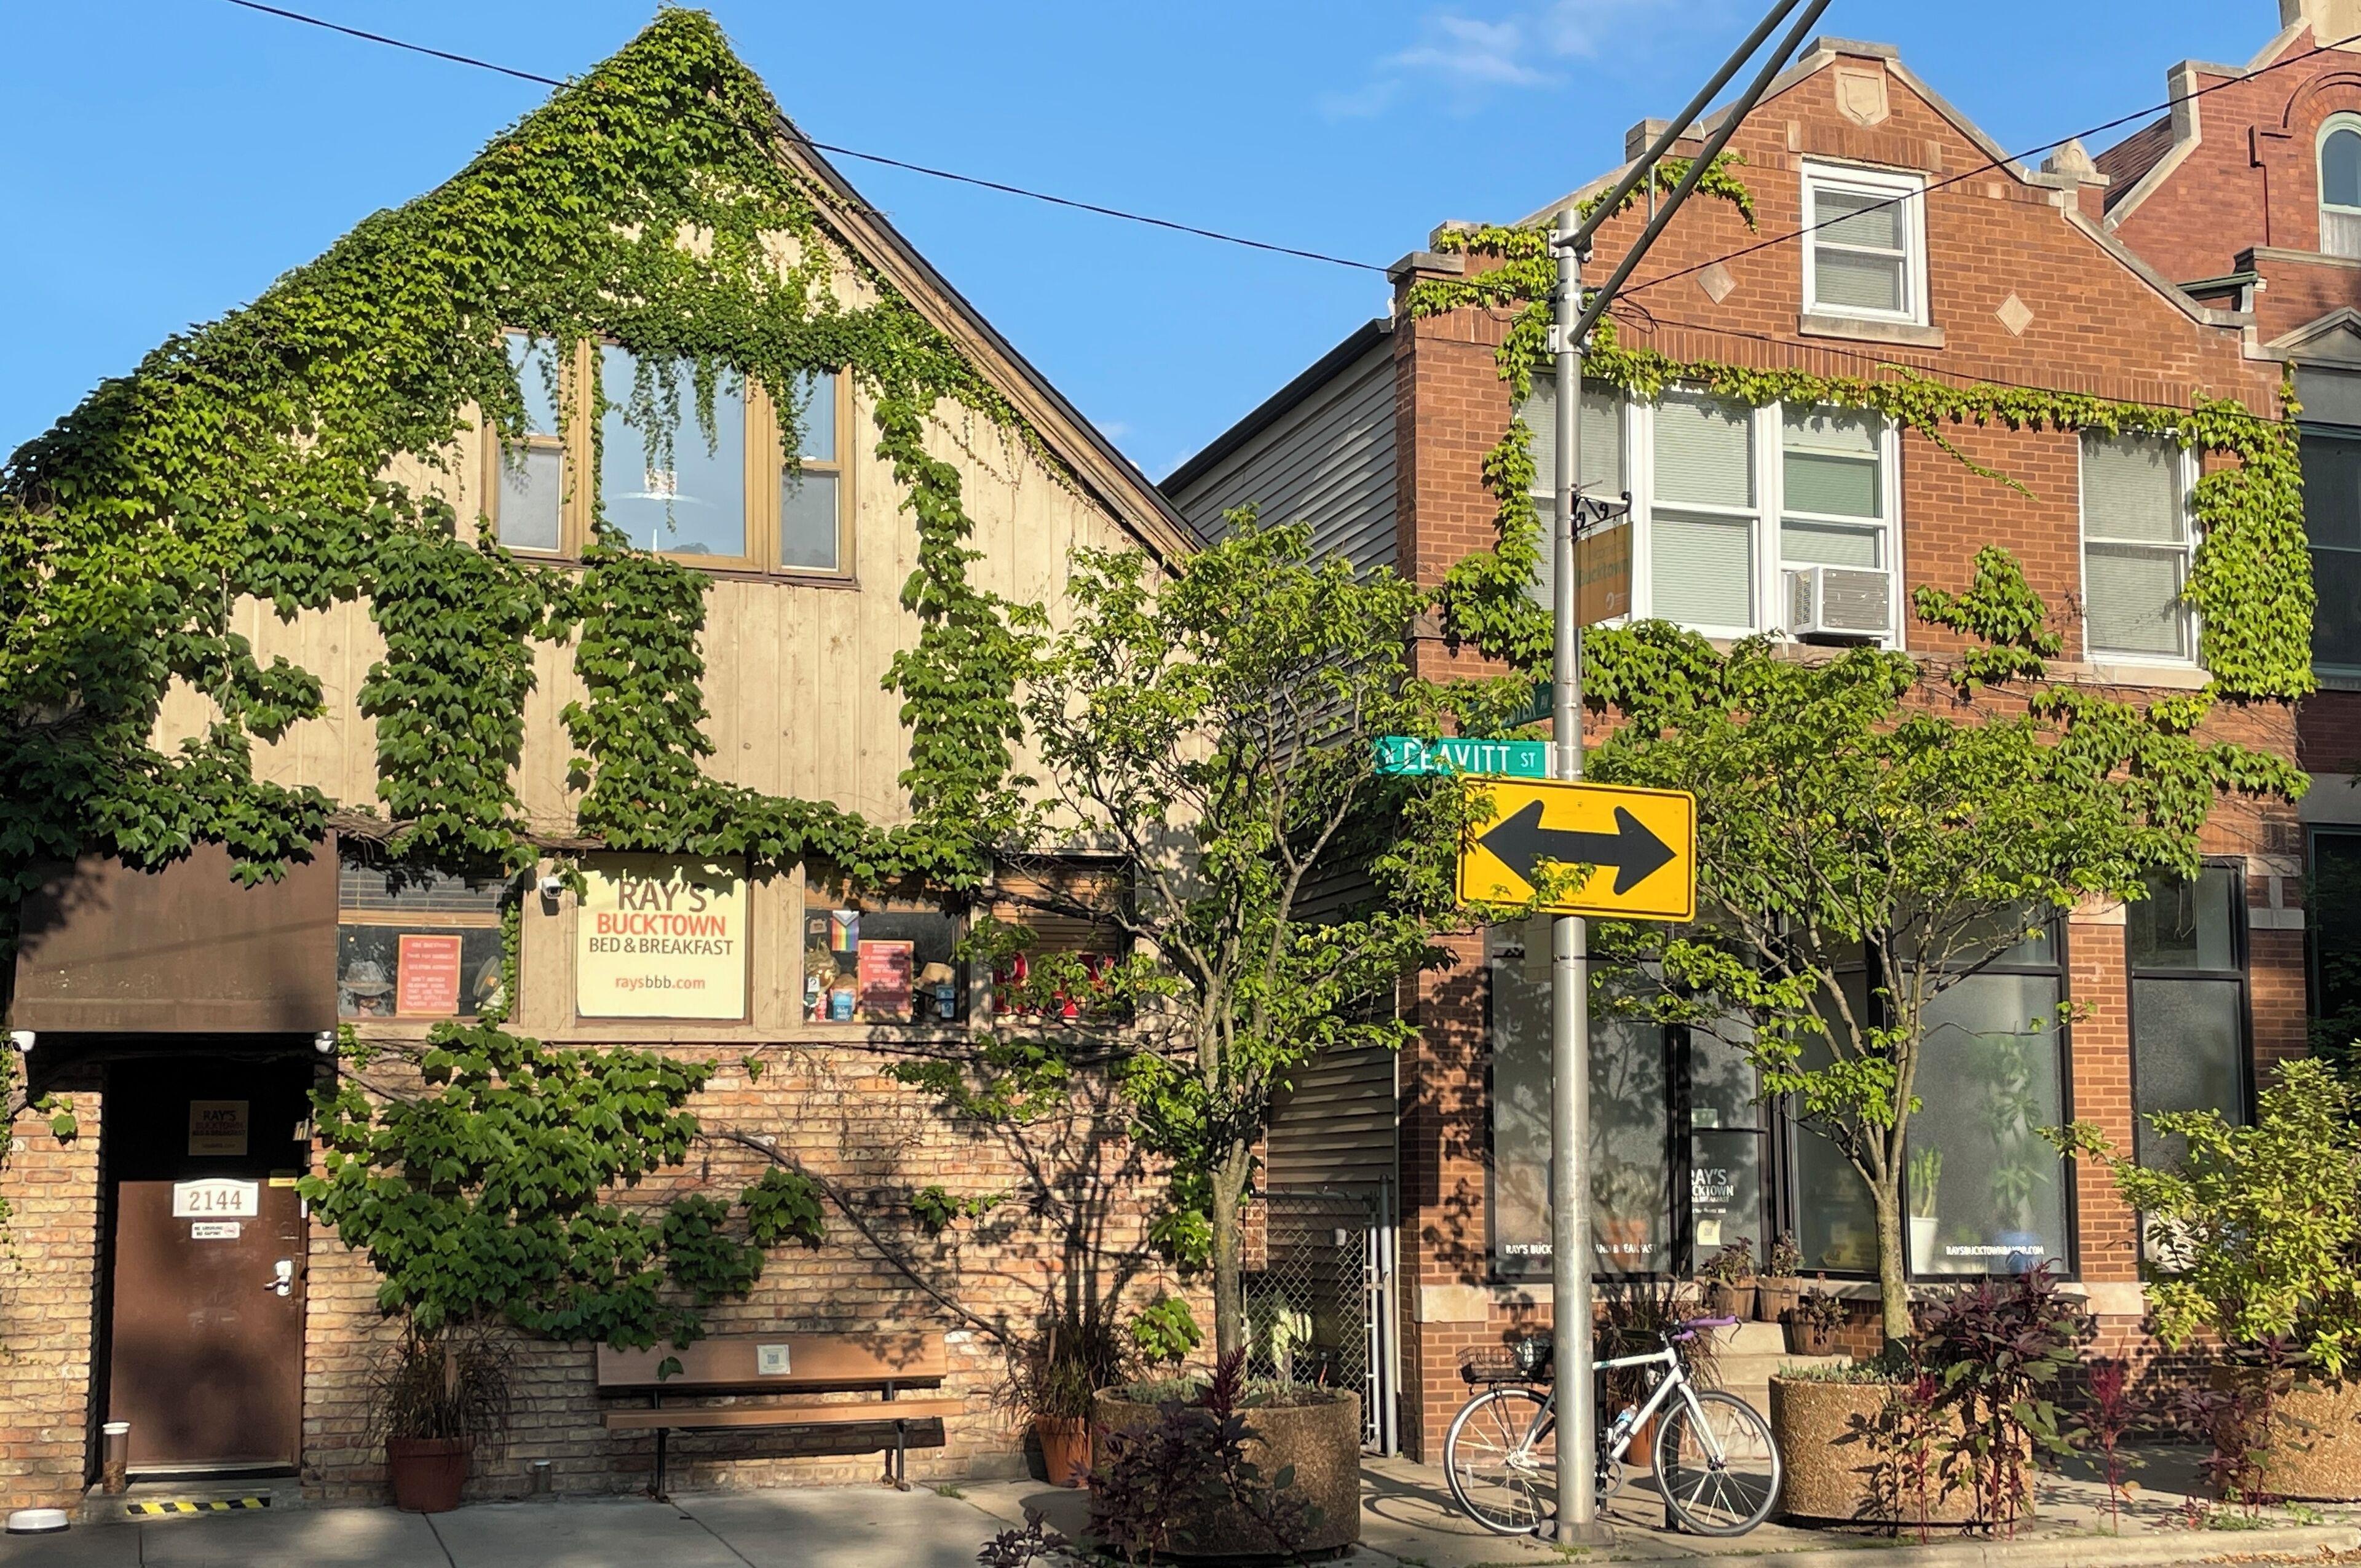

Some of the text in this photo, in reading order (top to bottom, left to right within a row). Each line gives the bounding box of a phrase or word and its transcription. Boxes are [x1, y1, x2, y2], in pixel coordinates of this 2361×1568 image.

[1403, 742, 1511, 772] LEAVITT
[1520, 752, 1536, 768] ST
[618, 880, 707, 913] RAY'S
[597, 913, 726, 936] BUCKTOWN
[589, 936, 734, 955] BED & BREAKFAST
[615, 975, 706, 991] raysbbb.com
[204, 1110, 237, 1121] RAY'S
[1691, 1184, 1734, 1196] CKTOWN
[189, 1190, 242, 1211] 2144
[1505, 1244, 1529, 1254] RAY'S
[1530, 1244, 1552, 1254] BUCK
[1613, 1243, 1658, 1254] BEAKFAST
